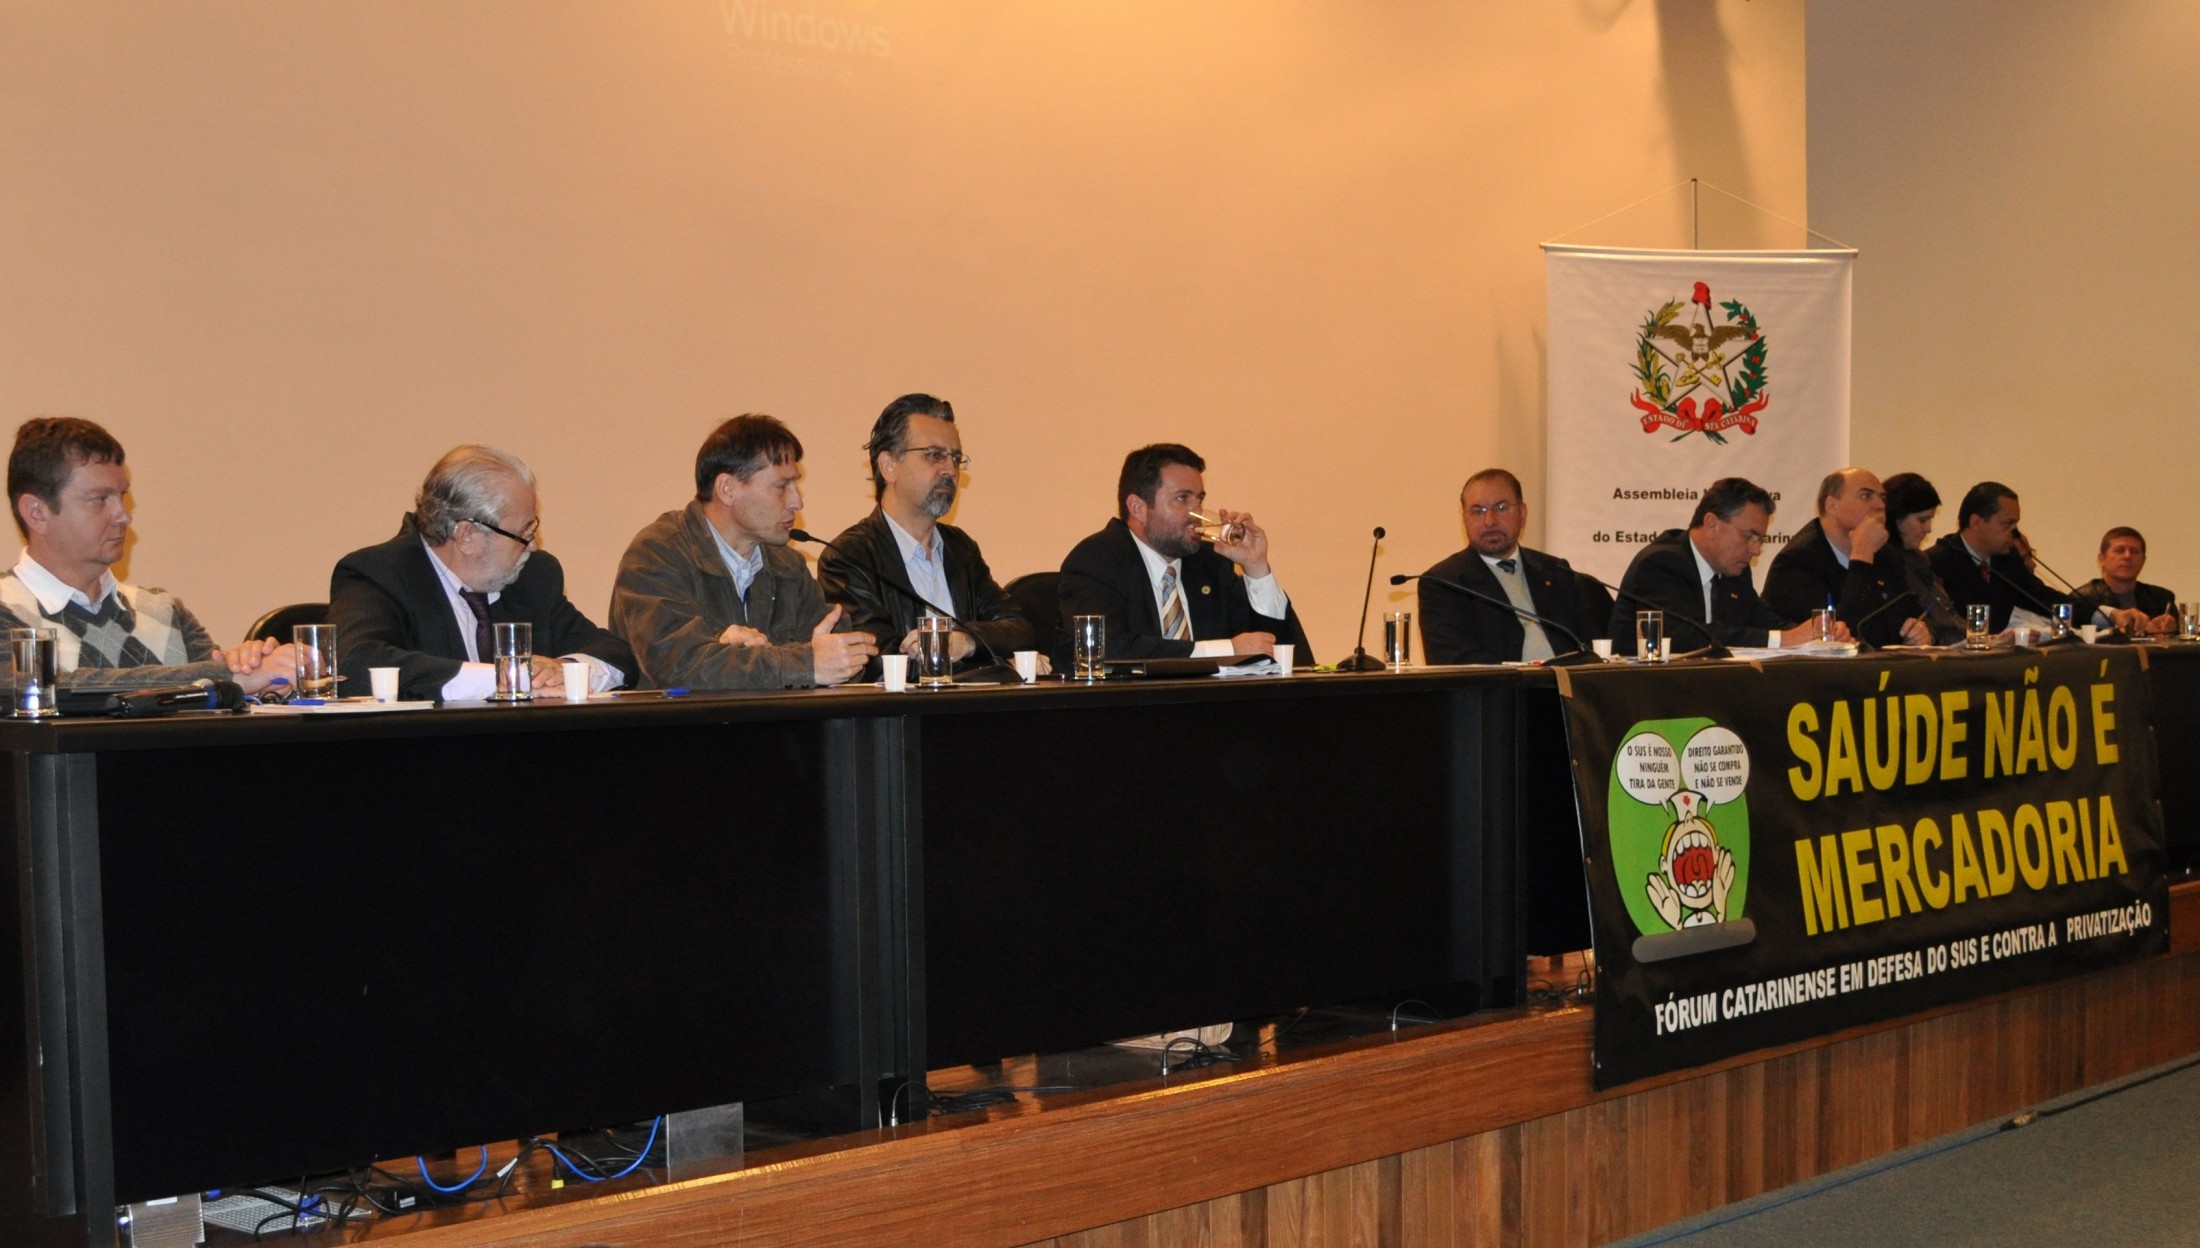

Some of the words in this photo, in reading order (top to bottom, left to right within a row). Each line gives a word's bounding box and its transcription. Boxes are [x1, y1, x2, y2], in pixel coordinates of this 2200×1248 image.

[719, 0, 890, 58] Windows
[1613, 488, 1698, 500] Assembleia
[1593, 531, 1610, 543] do
[1616, 531, 1658, 543] Estad
[1763, 532, 1791, 544] arin
[1787, 671, 1969, 801] SAÚDE
[1984, 666, 2078, 778] NÃO
[2090, 659, 2119, 765] É
[1627, 745, 1633, 757] O
[1634, 745, 1647, 757] SUS
[1653, 746, 1672, 757] NOSSO
[1687, 746, 1712, 757] DIREITO
[1712, 744, 1744, 756] GARANTIDO
[1639, 760, 1669, 773] NINGUÉM
[1694, 760, 1708, 773] NÃO
[1709, 761, 1717, 772] SE
[1718, 760, 1741, 771] COMPRA
[1629, 778, 1645, 789] TIRA
[1646, 778, 1656, 789] DA
[1657, 778, 1675, 789] GENTE
[1695, 778, 1699, 789] E
[1700, 775, 1715, 788] NÃO
[1716, 777, 1723, 787] SE
[1724, 775, 1742, 787] VENDE
[1795, 795, 2129, 936] MERCADORIA
[1655, 992, 1717, 1036] FÓRUM
[1722, 967, 1836, 1020] CATARINENSE
[1840, 962, 1863, 993] EM
[1868, 951, 1923, 988] DEFESA
[1927, 944, 1947, 974] DO
[1950, 937, 1977, 969] SUS
[1981, 935, 1990, 962] E
[1992, 924, 2046, 959] CONTRA
[2048, 921, 2058, 947] A
[2066, 899, 2152, 943] PRIVATIZAÇÃO
